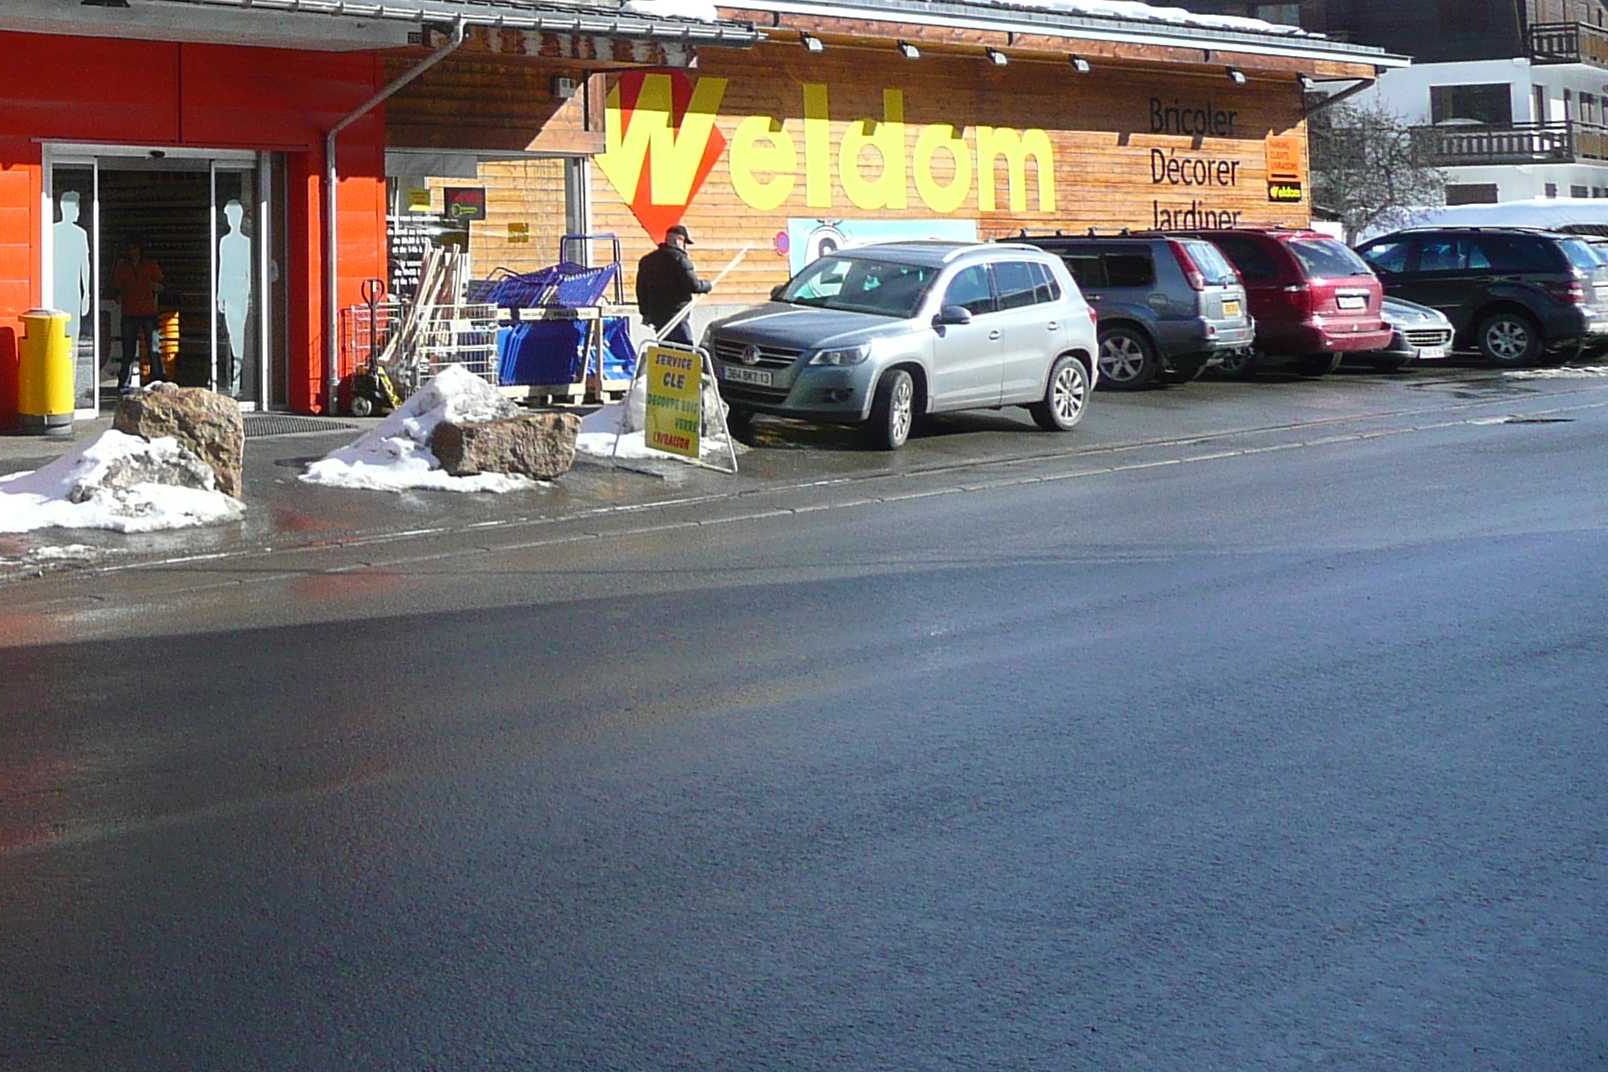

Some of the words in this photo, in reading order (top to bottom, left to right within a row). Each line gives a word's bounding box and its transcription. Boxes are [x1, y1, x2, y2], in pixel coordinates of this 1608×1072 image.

[1149, 96, 1239, 137] Bricoler
[594, 72, 1057, 213] Weldom
[1268, 140, 1290, 150] PARKING
[1151, 147, 1240, 187] Décorer
[1147, 199, 1242, 231] Jardiner
[655, 352, 693, 371] SERVICE
[663, 371, 686, 389] CLE
[674, 417, 698, 434] VERRE
[653, 431, 691, 450] LIVRAISON
